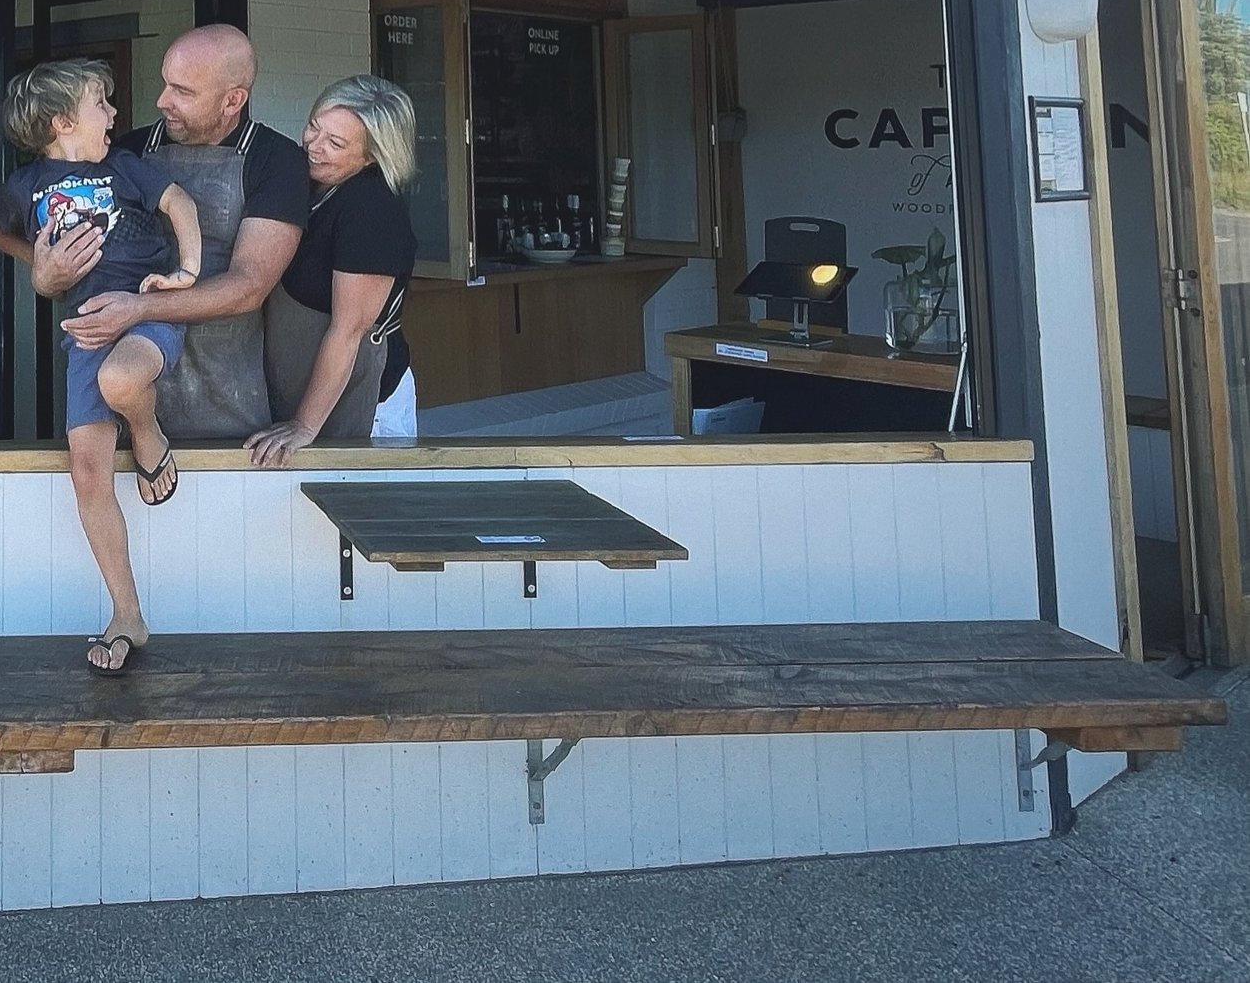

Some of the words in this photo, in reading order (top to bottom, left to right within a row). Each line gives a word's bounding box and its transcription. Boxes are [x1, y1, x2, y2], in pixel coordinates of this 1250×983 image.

[384, 14, 417, 29] ORDER
[388, 32, 414, 45] HERE
[527, 27, 559, 41] ONLINE
[529, 43, 547, 55] PICK
[548, 44, 560, 55] UP
